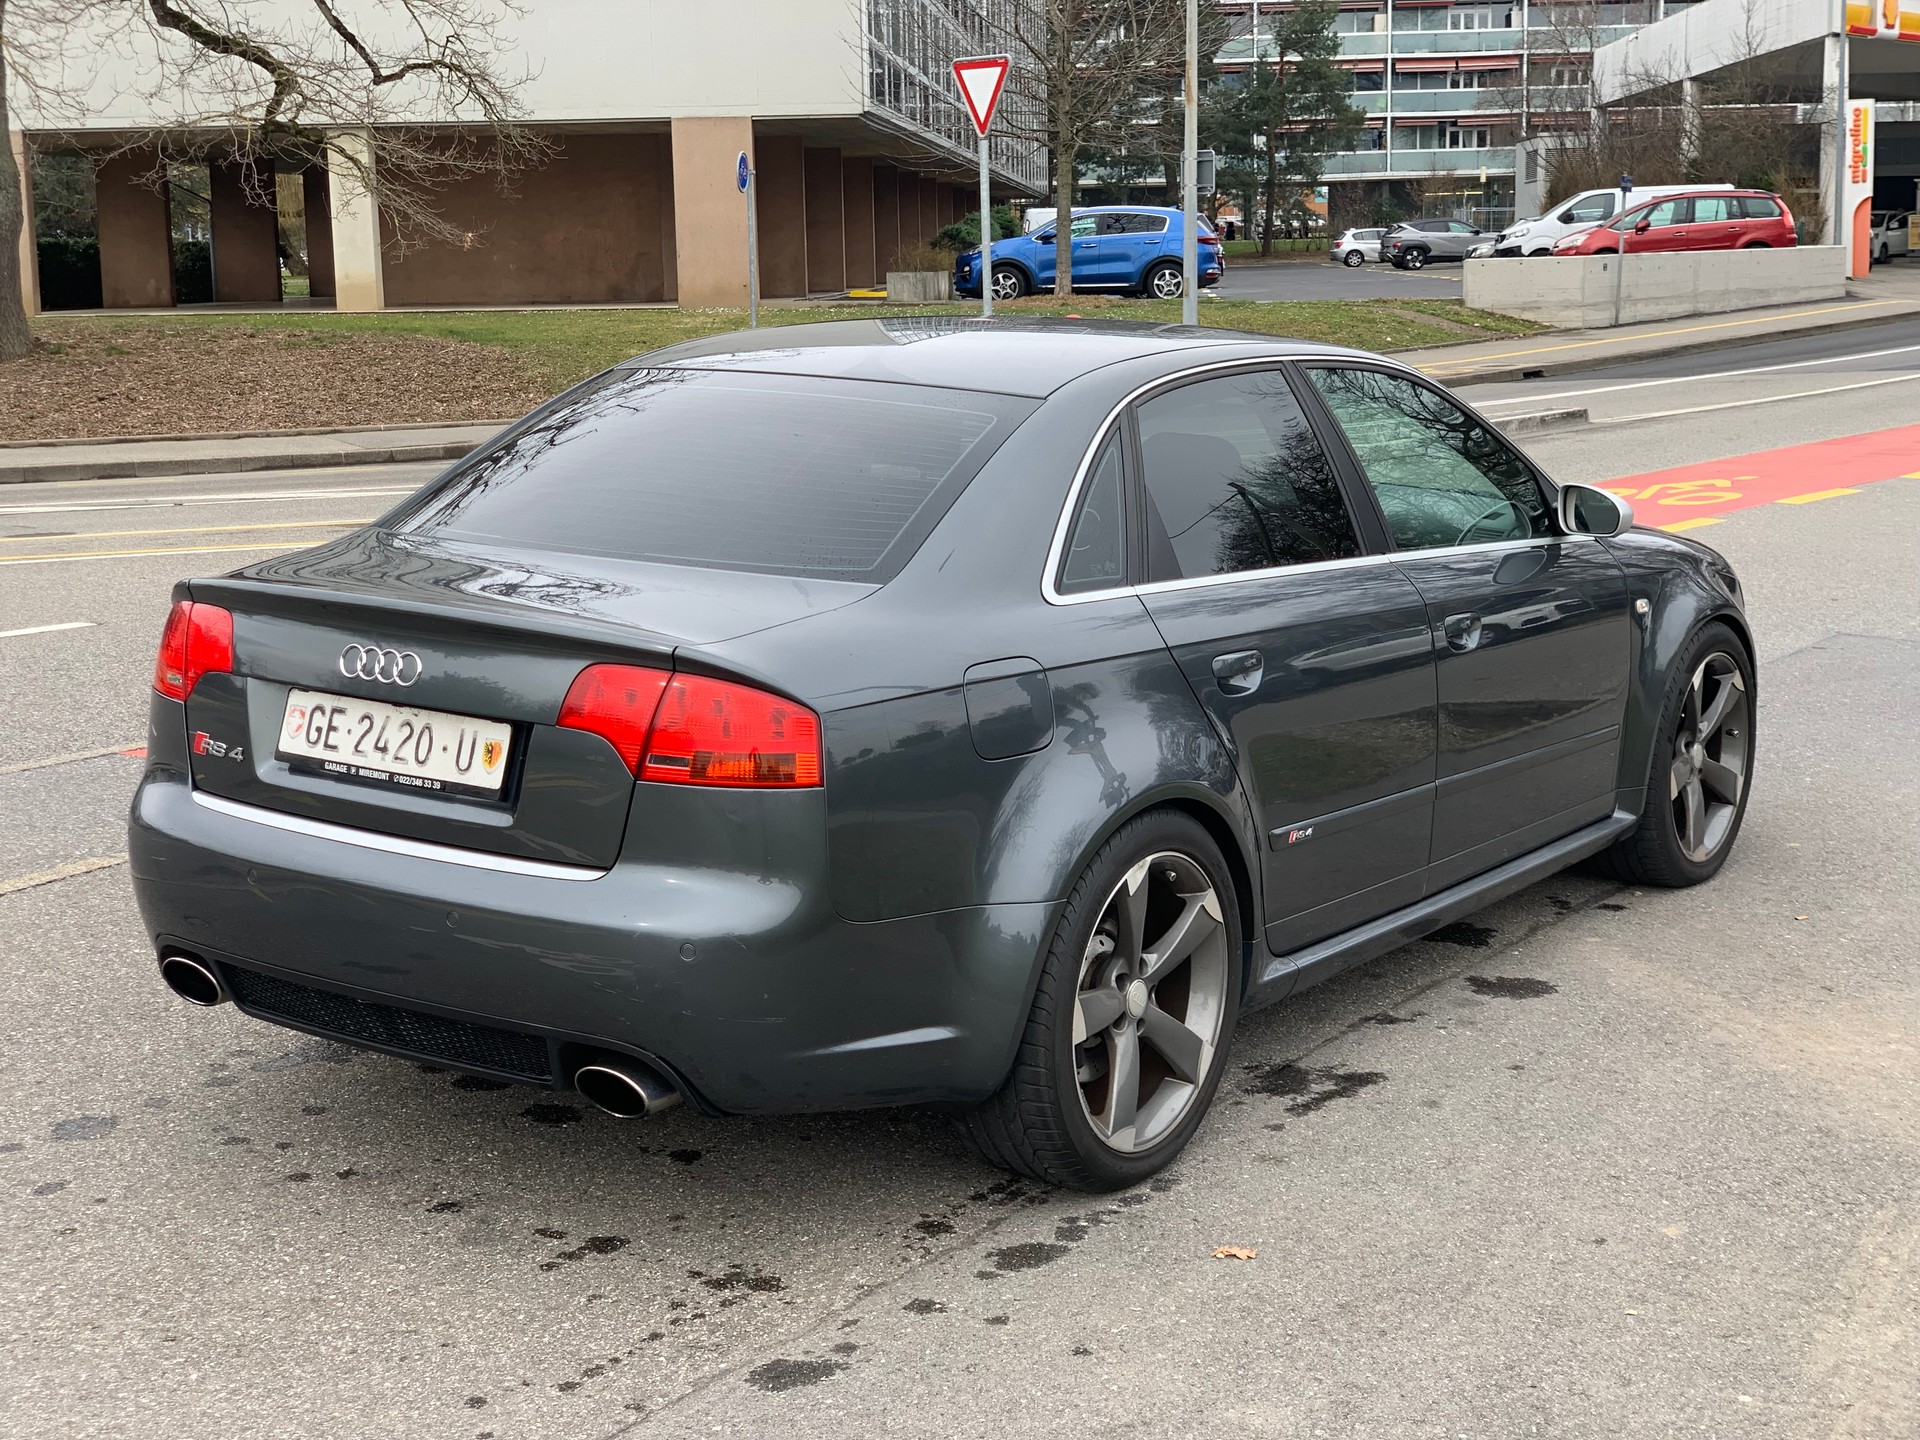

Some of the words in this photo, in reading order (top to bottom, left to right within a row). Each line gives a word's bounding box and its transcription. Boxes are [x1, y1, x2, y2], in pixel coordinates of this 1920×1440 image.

[1848, 107, 1864, 183] migrolino
[324, 761, 348, 773] GARAGE
[358, 768, 390, 781] MIREMONT
[423, 780, 432, 788] 33
[432, 782, 441, 790] 39
